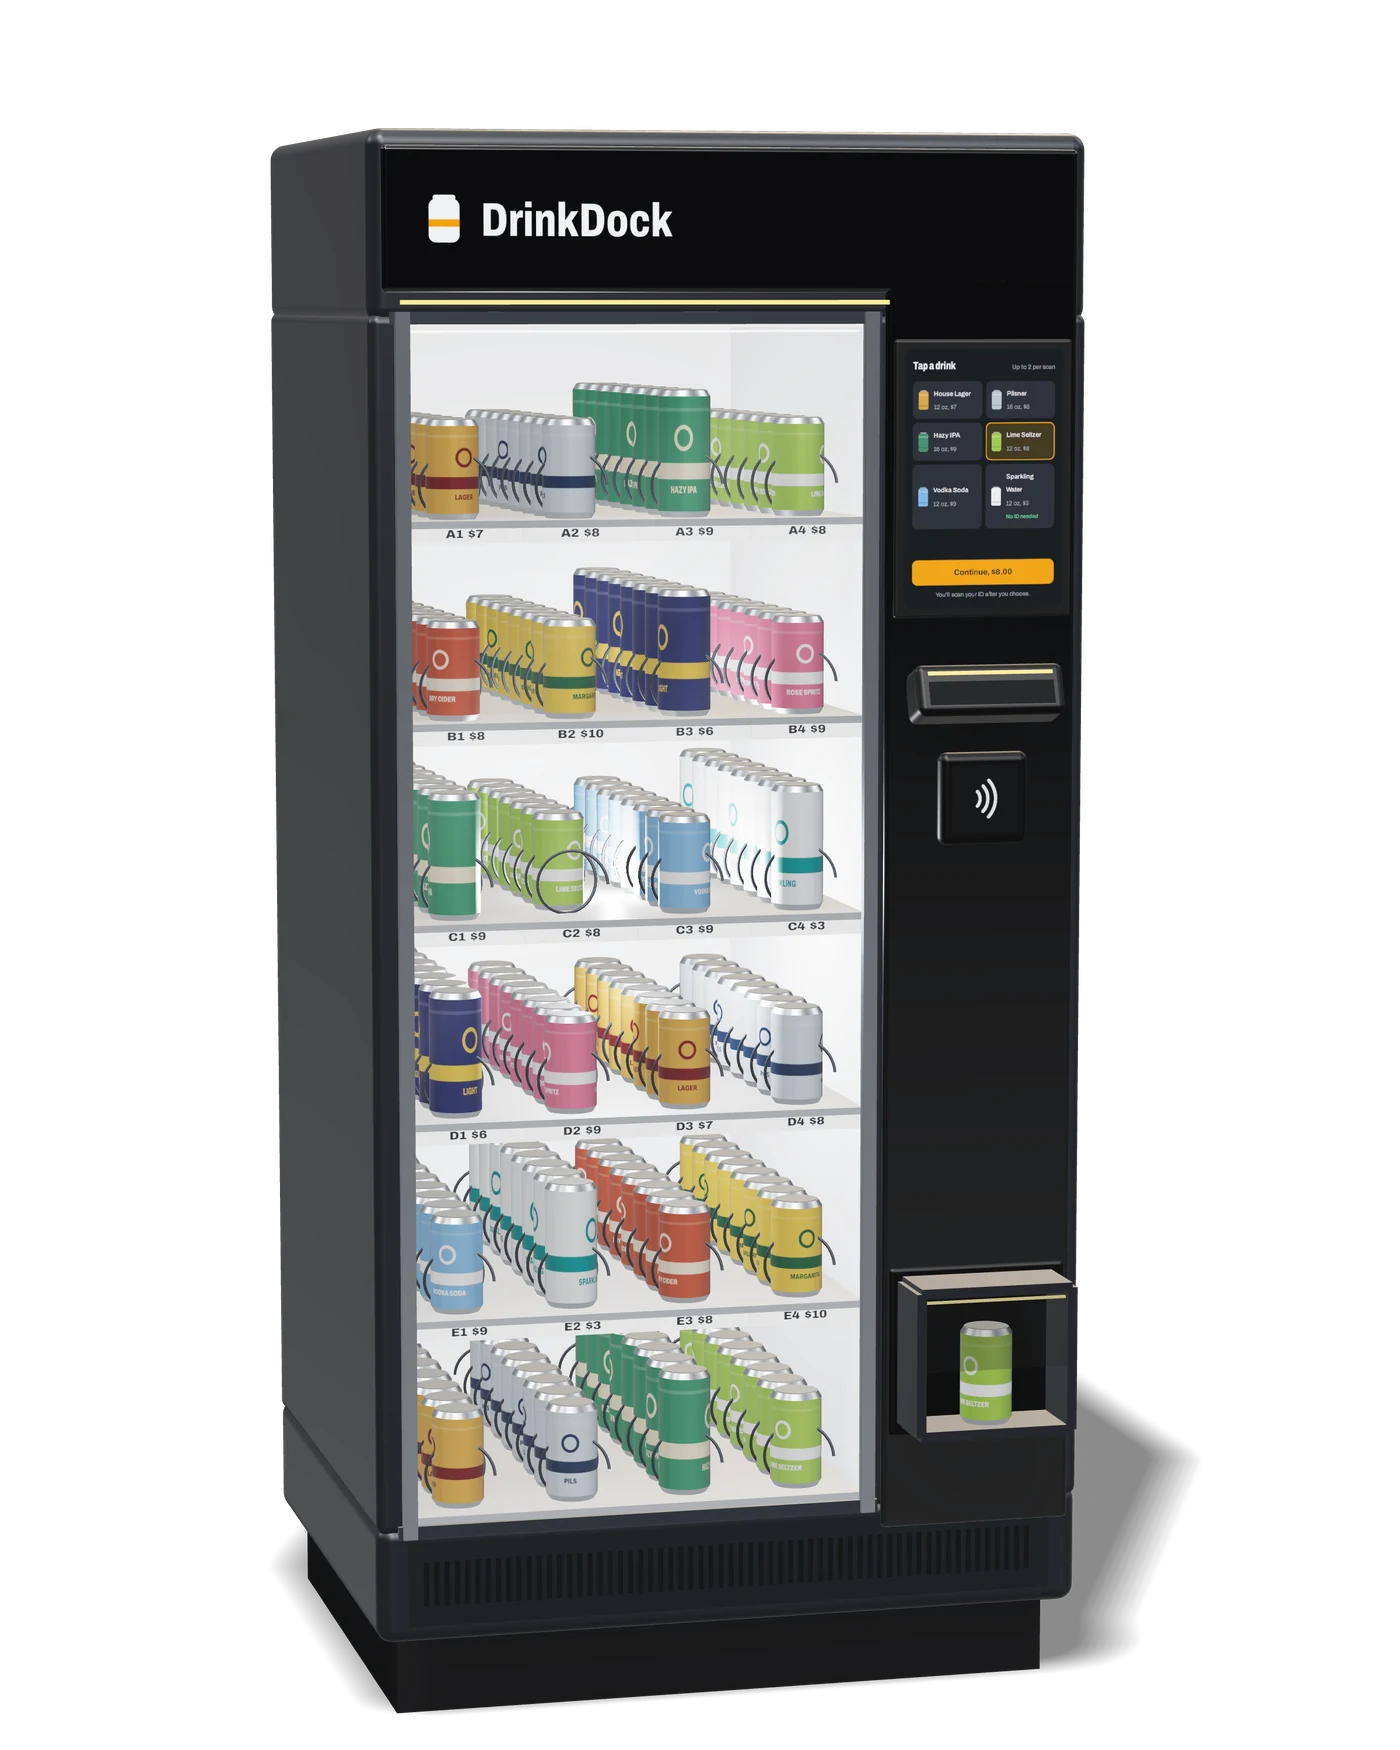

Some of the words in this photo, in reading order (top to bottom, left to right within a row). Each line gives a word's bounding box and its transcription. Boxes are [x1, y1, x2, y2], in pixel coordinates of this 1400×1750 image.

[483, 201, 672, 237] DrinkDock
[913, 362, 928, 371] Tap
[935, 361, 956, 370] drink
[670, 485, 687, 494] HAZY
[688, 485, 697, 494] IPA
[446, 530, 464, 538] A1
[468, 530, 484, 538] $7
[562, 528, 578, 538] A2
[584, 528, 600, 538] $8
[676, 526, 694, 536] A3
[698, 526, 714, 536] $9
[788, 526, 806, 534] A4
[812, 526, 826, 534] $8
[786, 688, 802, 696] ROSE
[558, 730, 576, 738] B2
[580, 728, 604, 738] $10
[676, 726, 694, 736] B3
[698, 726, 714, 736] $6
[788, 724, 806, 734] B4
[810, 724, 826, 734] $9
[448, 732, 464, 740] B1
[470, 732, 484, 740] $8
[676, 926, 694, 934] C3
[698, 924, 714, 934] $9
[788, 922, 806, 930] C4
[810, 922, 826, 930] $3
[448, 932, 466, 942] C1
[470, 932, 486, 940] $9
[562, 928, 580, 938] C2
[586, 928, 600, 938] $8
[462, 1086, 478, 1096] LIGHT
[676, 1122, 694, 1130] D3
[698, 1120, 714, 1130] $7
[788, 1118, 804, 1126] D4
[810, 1116, 824, 1124] $8
[450, 1132, 466, 1140] D1
[472, 1130, 488, 1138] $6
[564, 1126, 580, 1136] D2
[586, 1126, 602, 1134] $9
[784, 1310, 800, 1320] E4
[804, 1310, 828, 1318] $10
[564, 1322, 580, 1332] E2
[586, 1320, 602, 1330] $3
[676, 1316, 692, 1326] E3
[698, 1316, 712, 1324] $8
[452, 1328, 468, 1336] E1
[472, 1326, 488, 1336] $9
[965, 1400, 989, 1408] SELTZER
